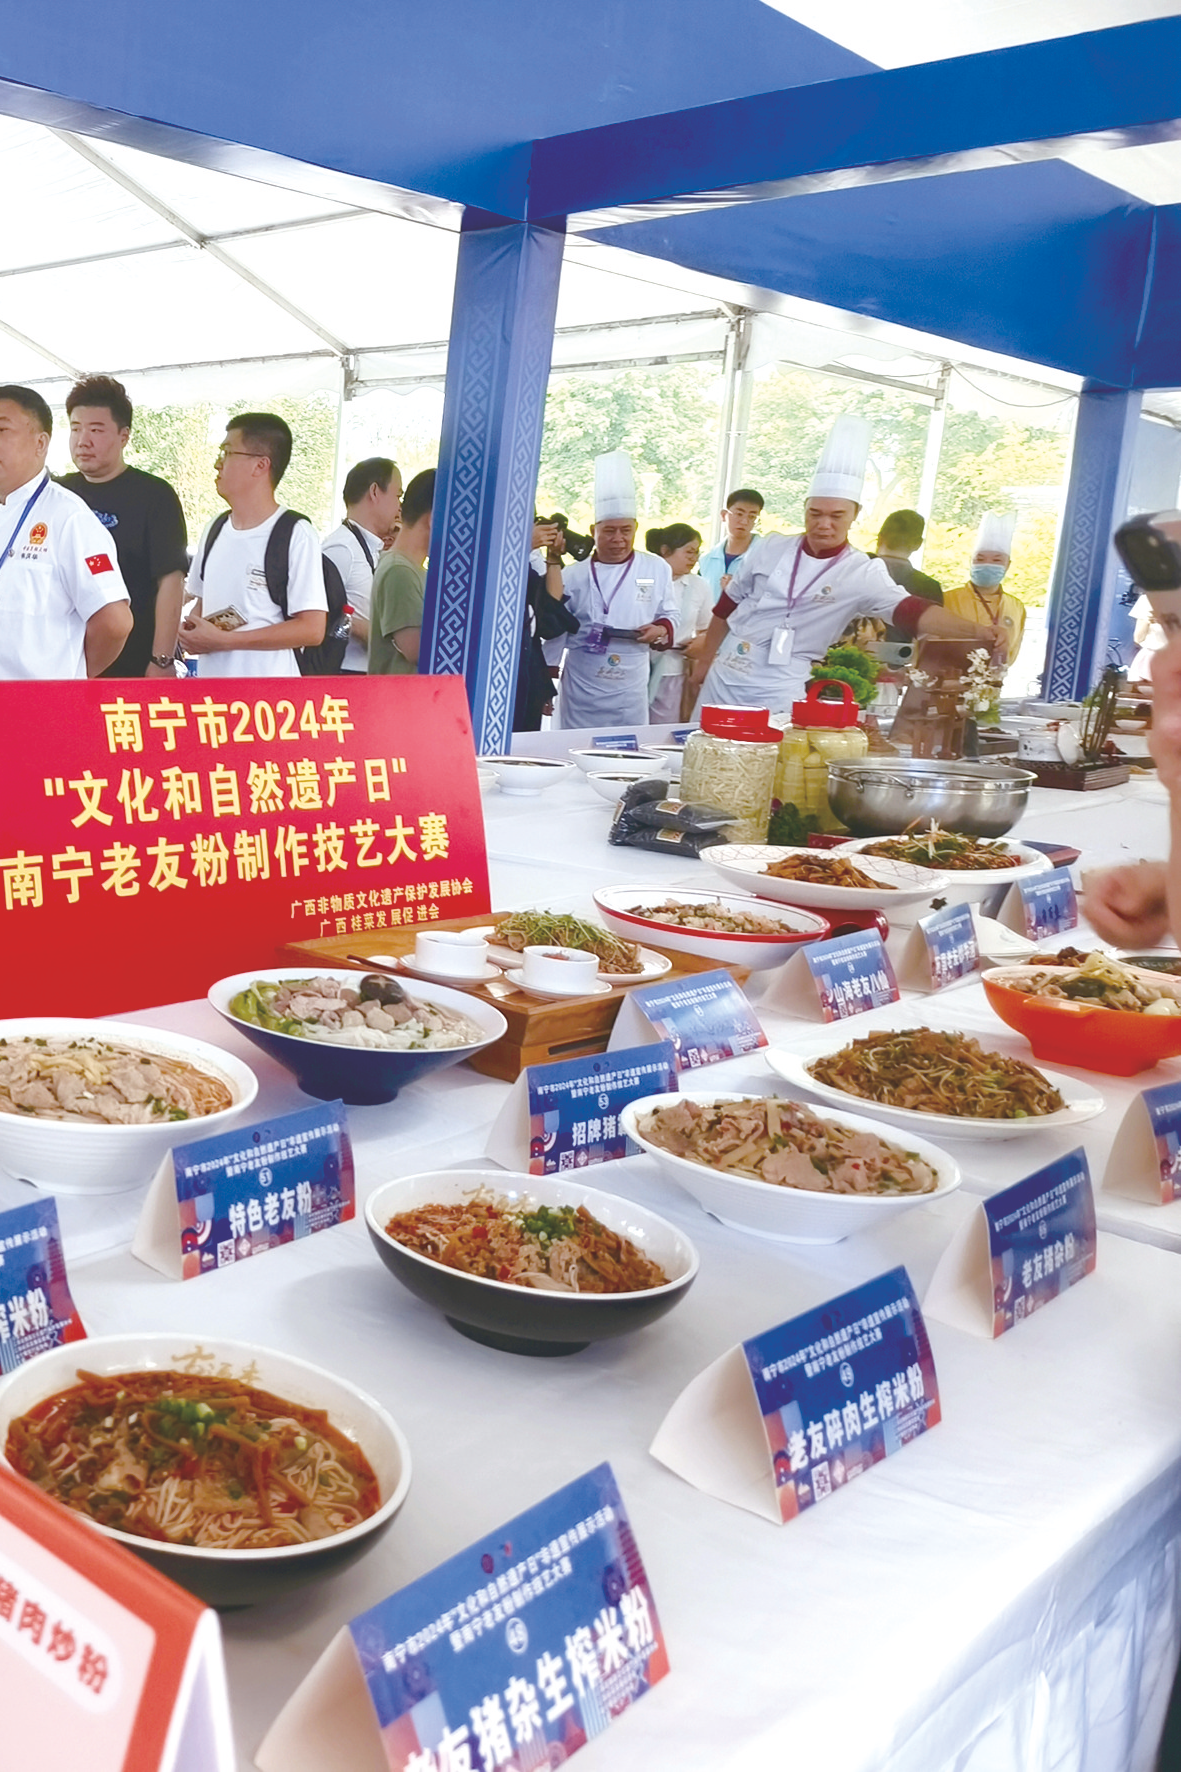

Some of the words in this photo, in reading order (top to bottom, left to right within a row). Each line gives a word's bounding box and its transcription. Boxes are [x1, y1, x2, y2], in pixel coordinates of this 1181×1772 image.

[100, 695, 354, 753] 南宁市2024年
[290, 877, 474, 919] 广西非物质文化遗产保护发展协会
[572, 1114, 627, 1147] 招牌猪
[228, 1181, 312, 1239] 特色老友粉
